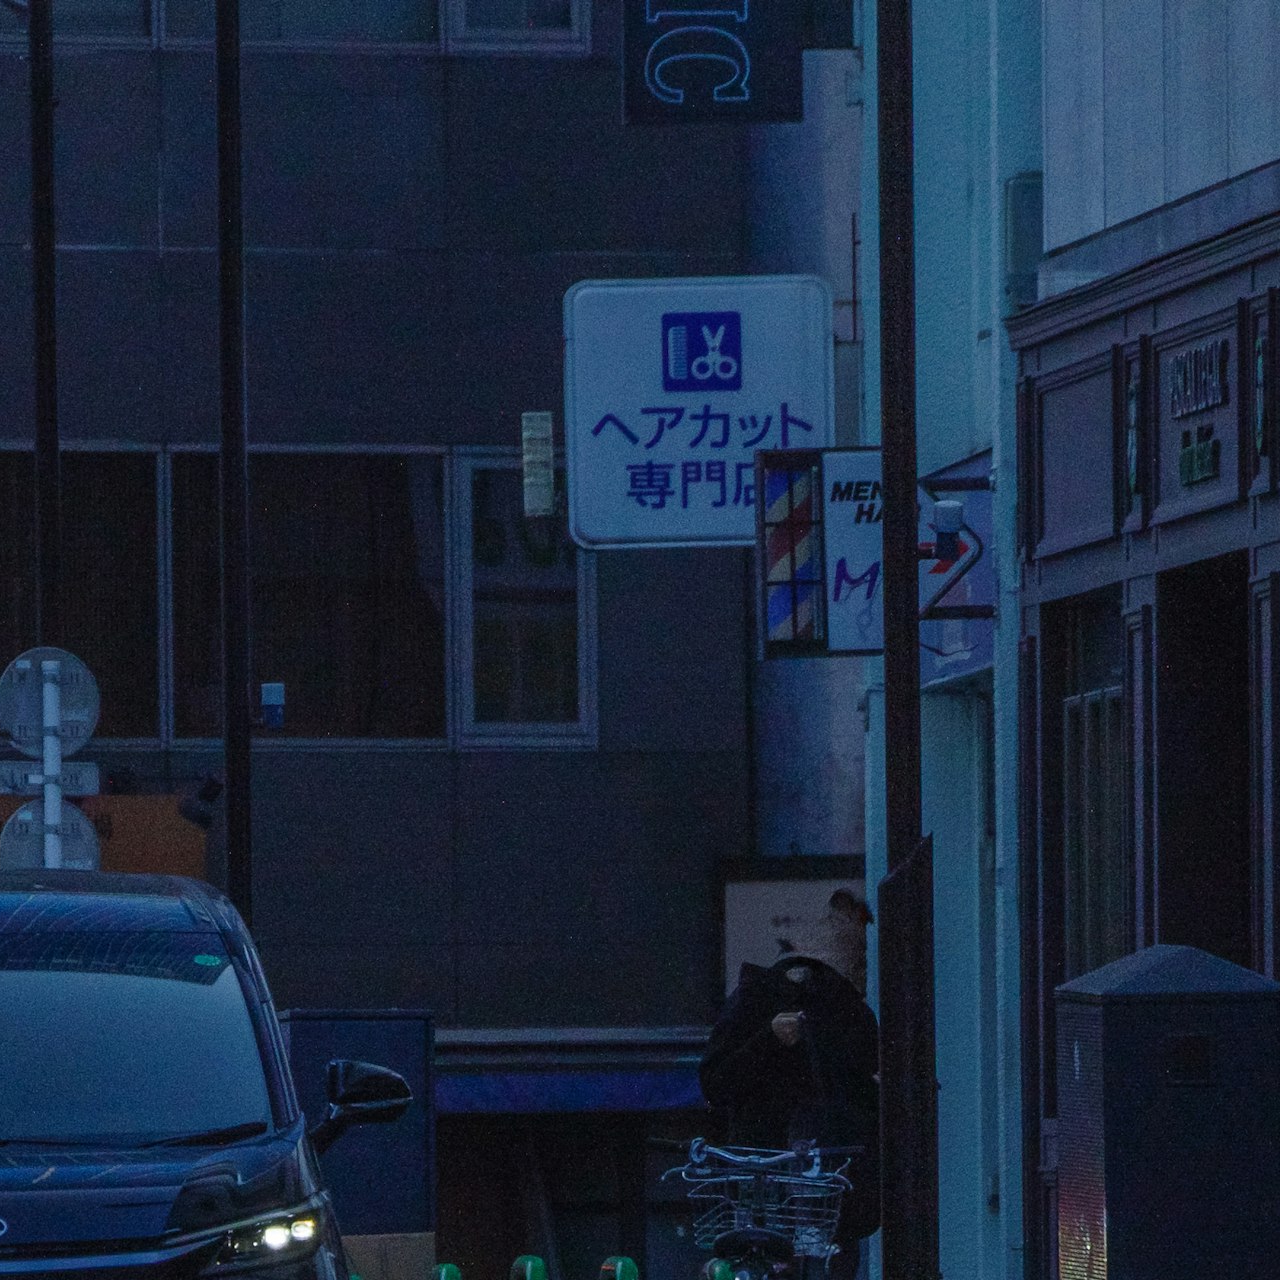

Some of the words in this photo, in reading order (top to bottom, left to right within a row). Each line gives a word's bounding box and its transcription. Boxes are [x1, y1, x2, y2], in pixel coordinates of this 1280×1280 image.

[591, 402, 813, 450] ヘアカット
